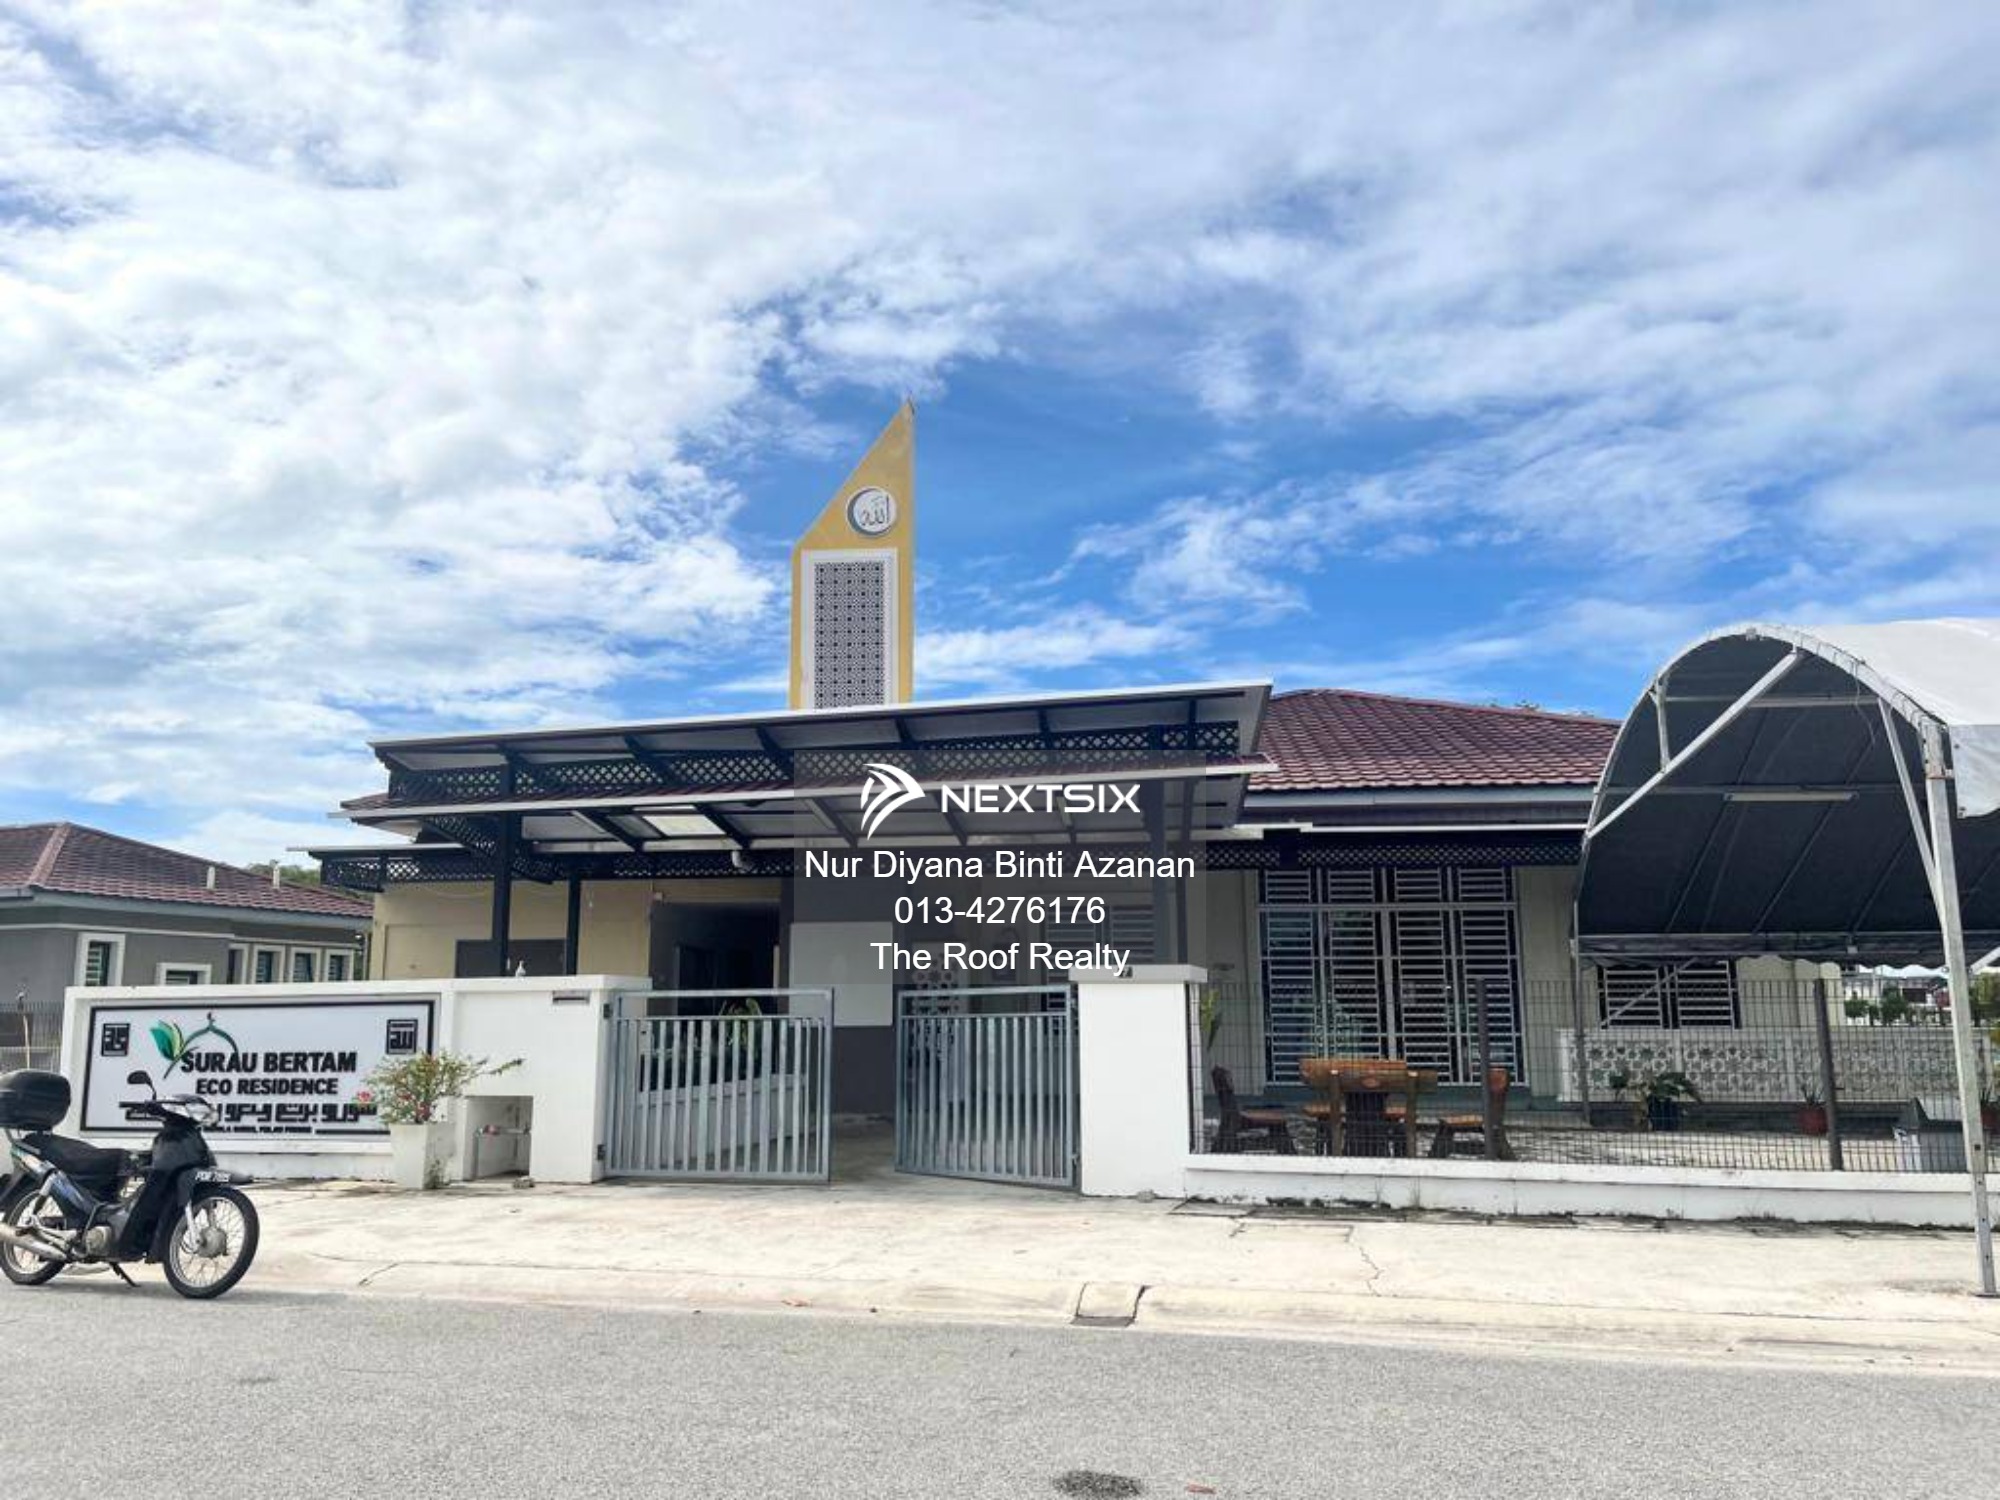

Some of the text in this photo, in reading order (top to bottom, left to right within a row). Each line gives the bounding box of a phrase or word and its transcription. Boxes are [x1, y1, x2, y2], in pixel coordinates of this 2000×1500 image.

[181, 1051, 357, 1073] SURAU BERTAM
[196, 1078, 339, 1096] ECO RESIDENCE
